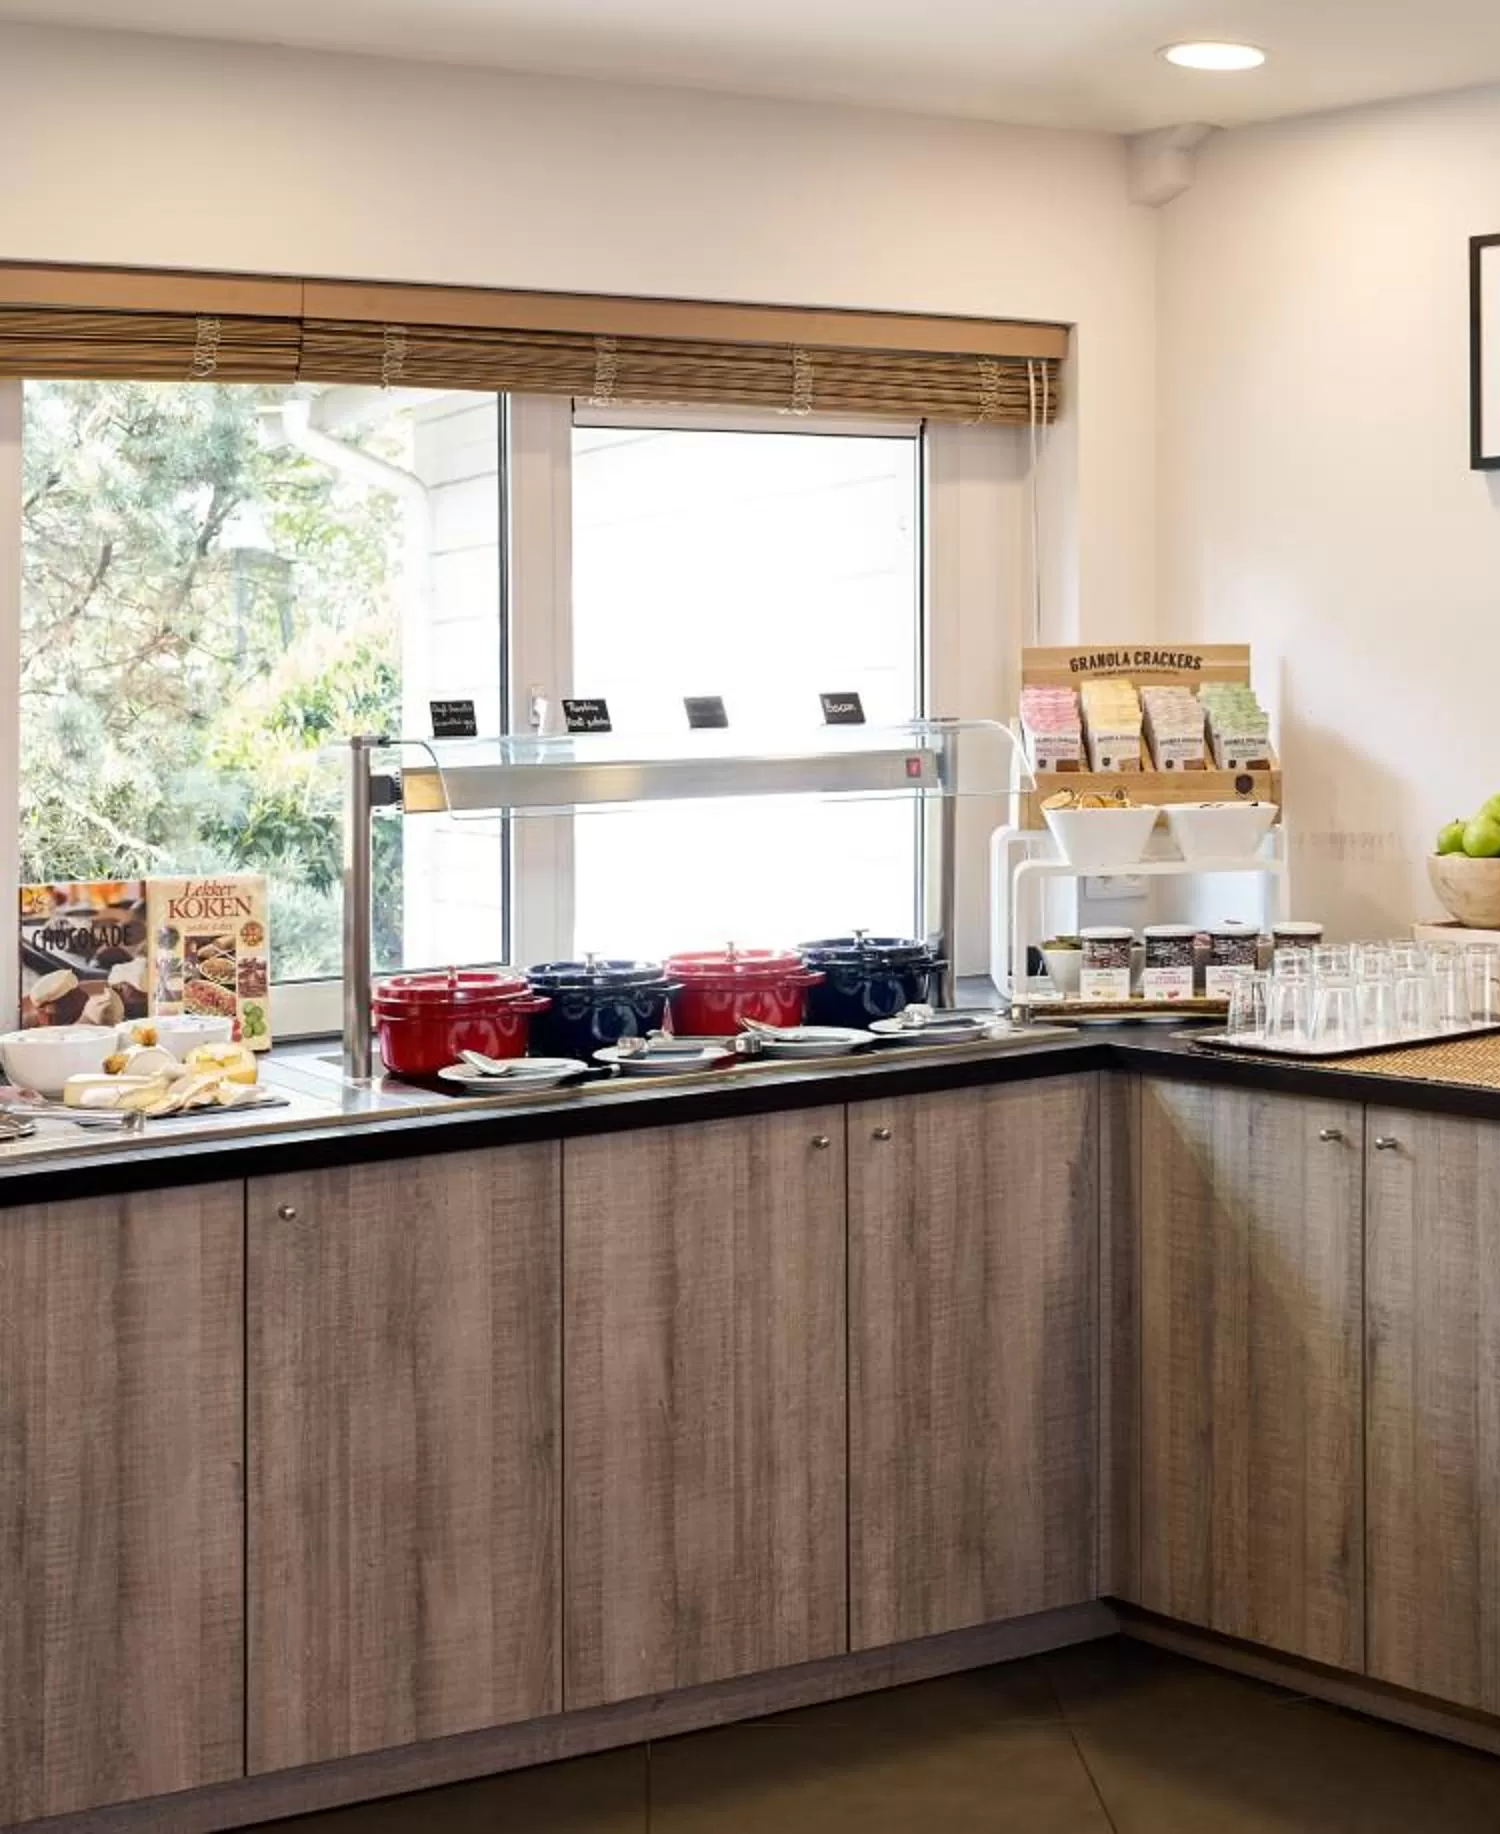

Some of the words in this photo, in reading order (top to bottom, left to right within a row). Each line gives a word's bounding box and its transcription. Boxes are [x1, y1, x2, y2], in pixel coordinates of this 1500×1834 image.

[1069, 652, 1131, 672] GRANOLA
[1133, 651, 1203, 670] CRACKERS
[168, 896, 253, 919] KOKEN
[32, 925, 133, 951] CHOCOLADE
